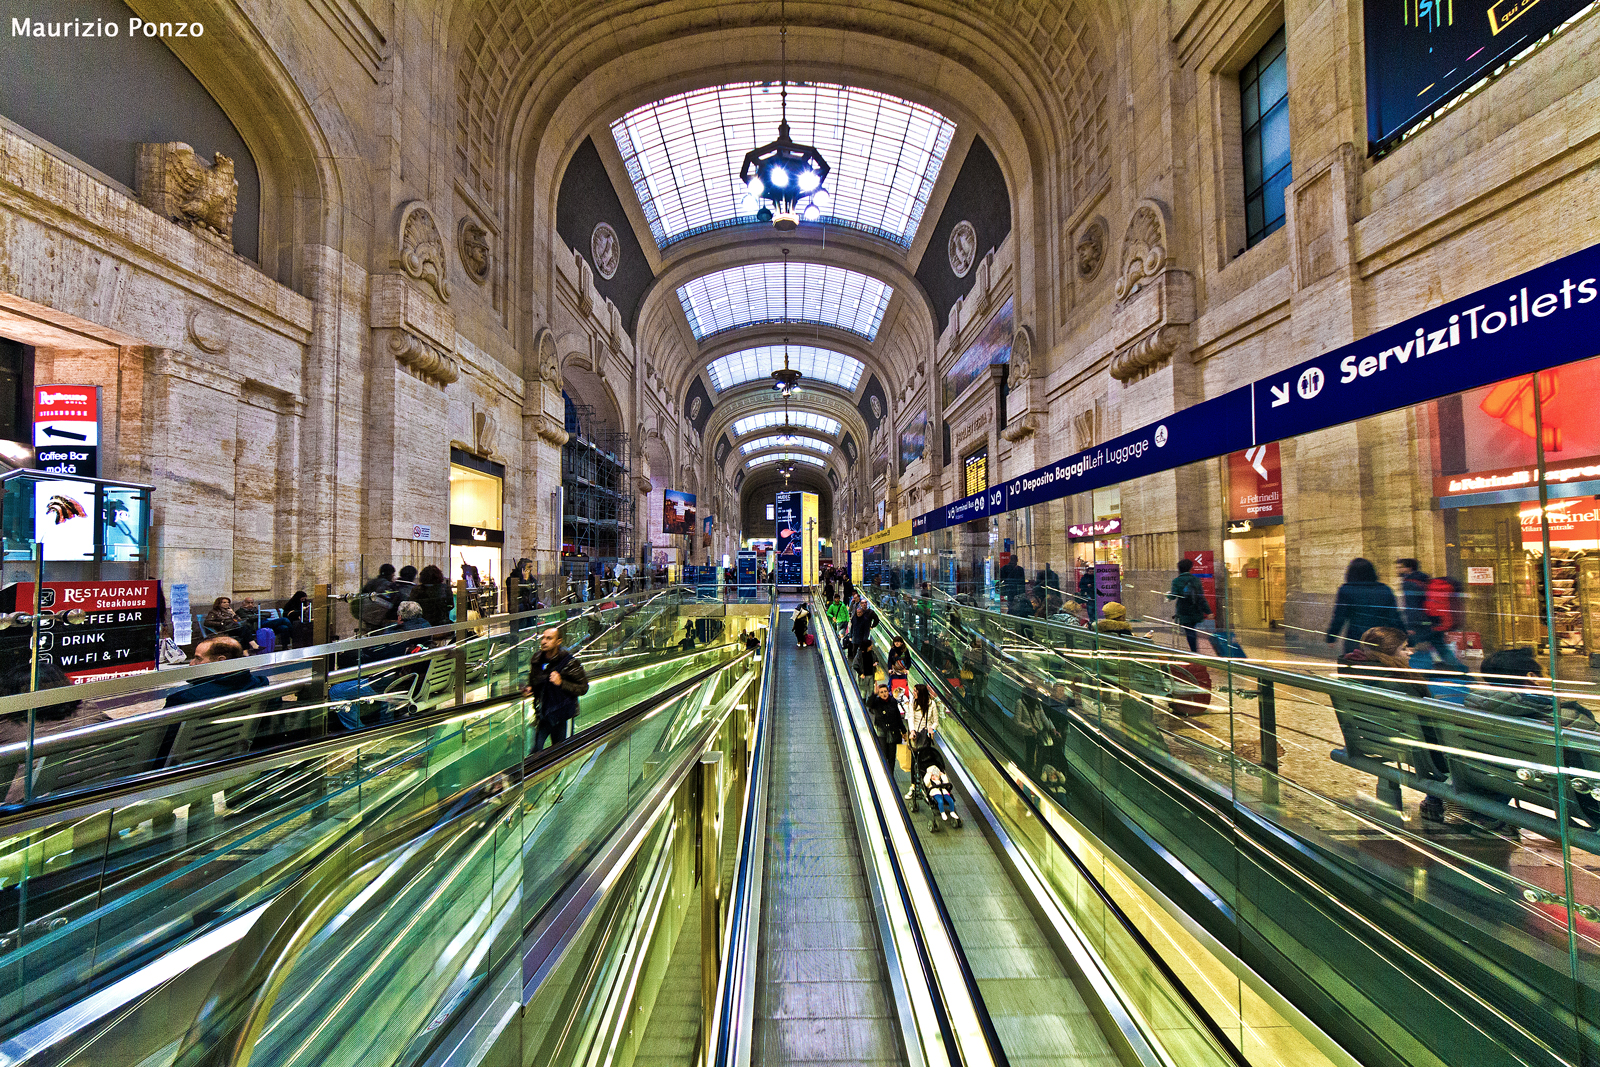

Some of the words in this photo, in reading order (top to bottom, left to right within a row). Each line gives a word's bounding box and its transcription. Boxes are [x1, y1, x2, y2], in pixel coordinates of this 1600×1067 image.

[1340, 314, 1460, 384] Servizi
[1461, 278, 1598, 340] Toilets
[39, 451, 68, 461] Coffee
[69, 451, 89, 461] Bar
[1023, 471, 1054, 491] Deposito
[1055, 455, 1089, 480] Bagagli
[1089, 450, 1103, 469] Left
[1105, 439, 1149, 464] Luggage
[1461, 471, 1530, 490] Feltrinelli
[1247, 491, 1279, 504] Feltrinelli
[1246, 505, 1273, 514] express
[63, 587, 150, 603] RESTAURANT
[96, 599, 147, 608] Steakhouse
[118, 612, 142, 622] BAR
[62, 632, 105, 646] DRINK
[61, 652, 98, 666] WI-FI
[102, 651, 111, 661] &
[115, 648, 131, 659] TV
